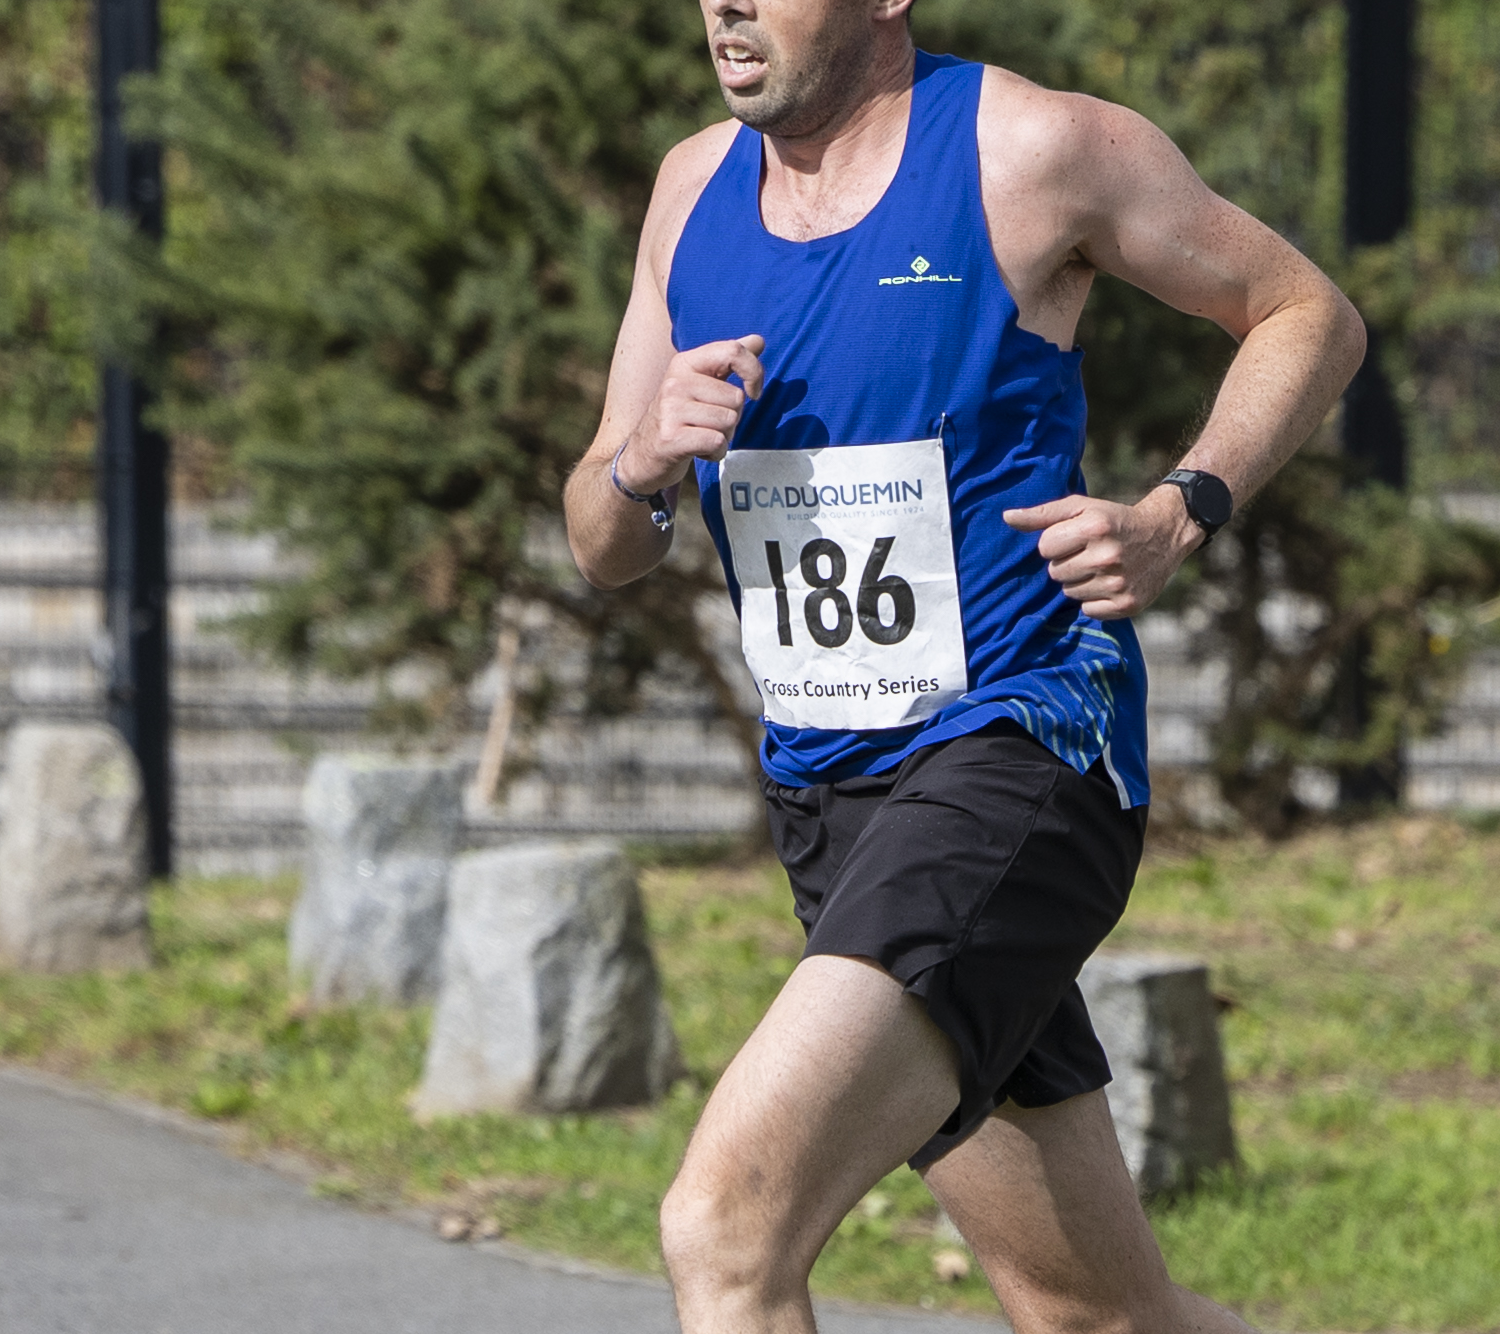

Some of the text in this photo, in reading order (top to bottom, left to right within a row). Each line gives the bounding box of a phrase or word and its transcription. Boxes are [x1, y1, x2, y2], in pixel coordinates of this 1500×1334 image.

[879, 274, 962, 286] RONHILL
[787, 506, 925, 521] BUILDING QUALITY SINCE 1924
[764, 536, 916, 648] 186
[763, 675, 939, 700] Cross Country Series
